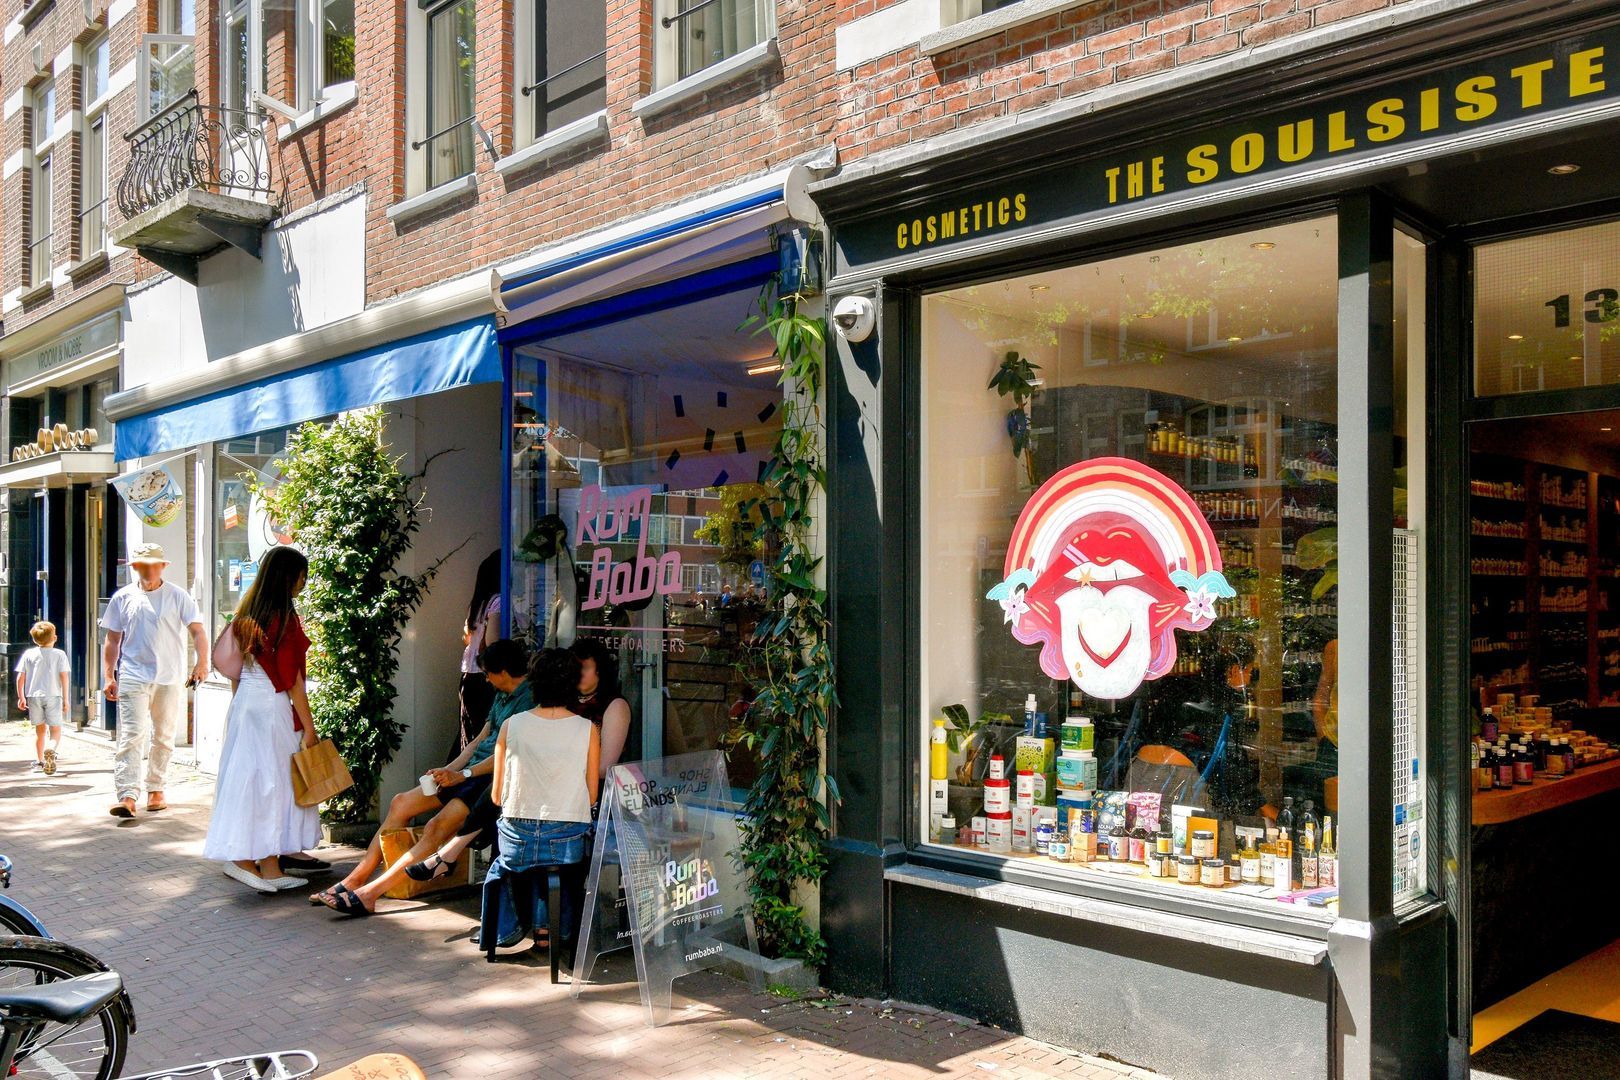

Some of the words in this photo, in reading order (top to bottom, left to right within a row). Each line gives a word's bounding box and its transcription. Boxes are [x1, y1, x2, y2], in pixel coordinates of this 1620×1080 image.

[1105, 156, 1165, 204] THE
[1187, 46, 1606, 184] SOULSISTE
[897, 193, 1026, 249] COSMETICS
[623, 780, 657, 797] SHOP
[625, 792, 675, 811] ELANDS
[665, 858, 701, 888] Rum
[673, 878, 720, 911] Baba
[672, 908, 724, 927] COFFEEROASTERS
[685, 943, 723, 962] rumbaba.nl
